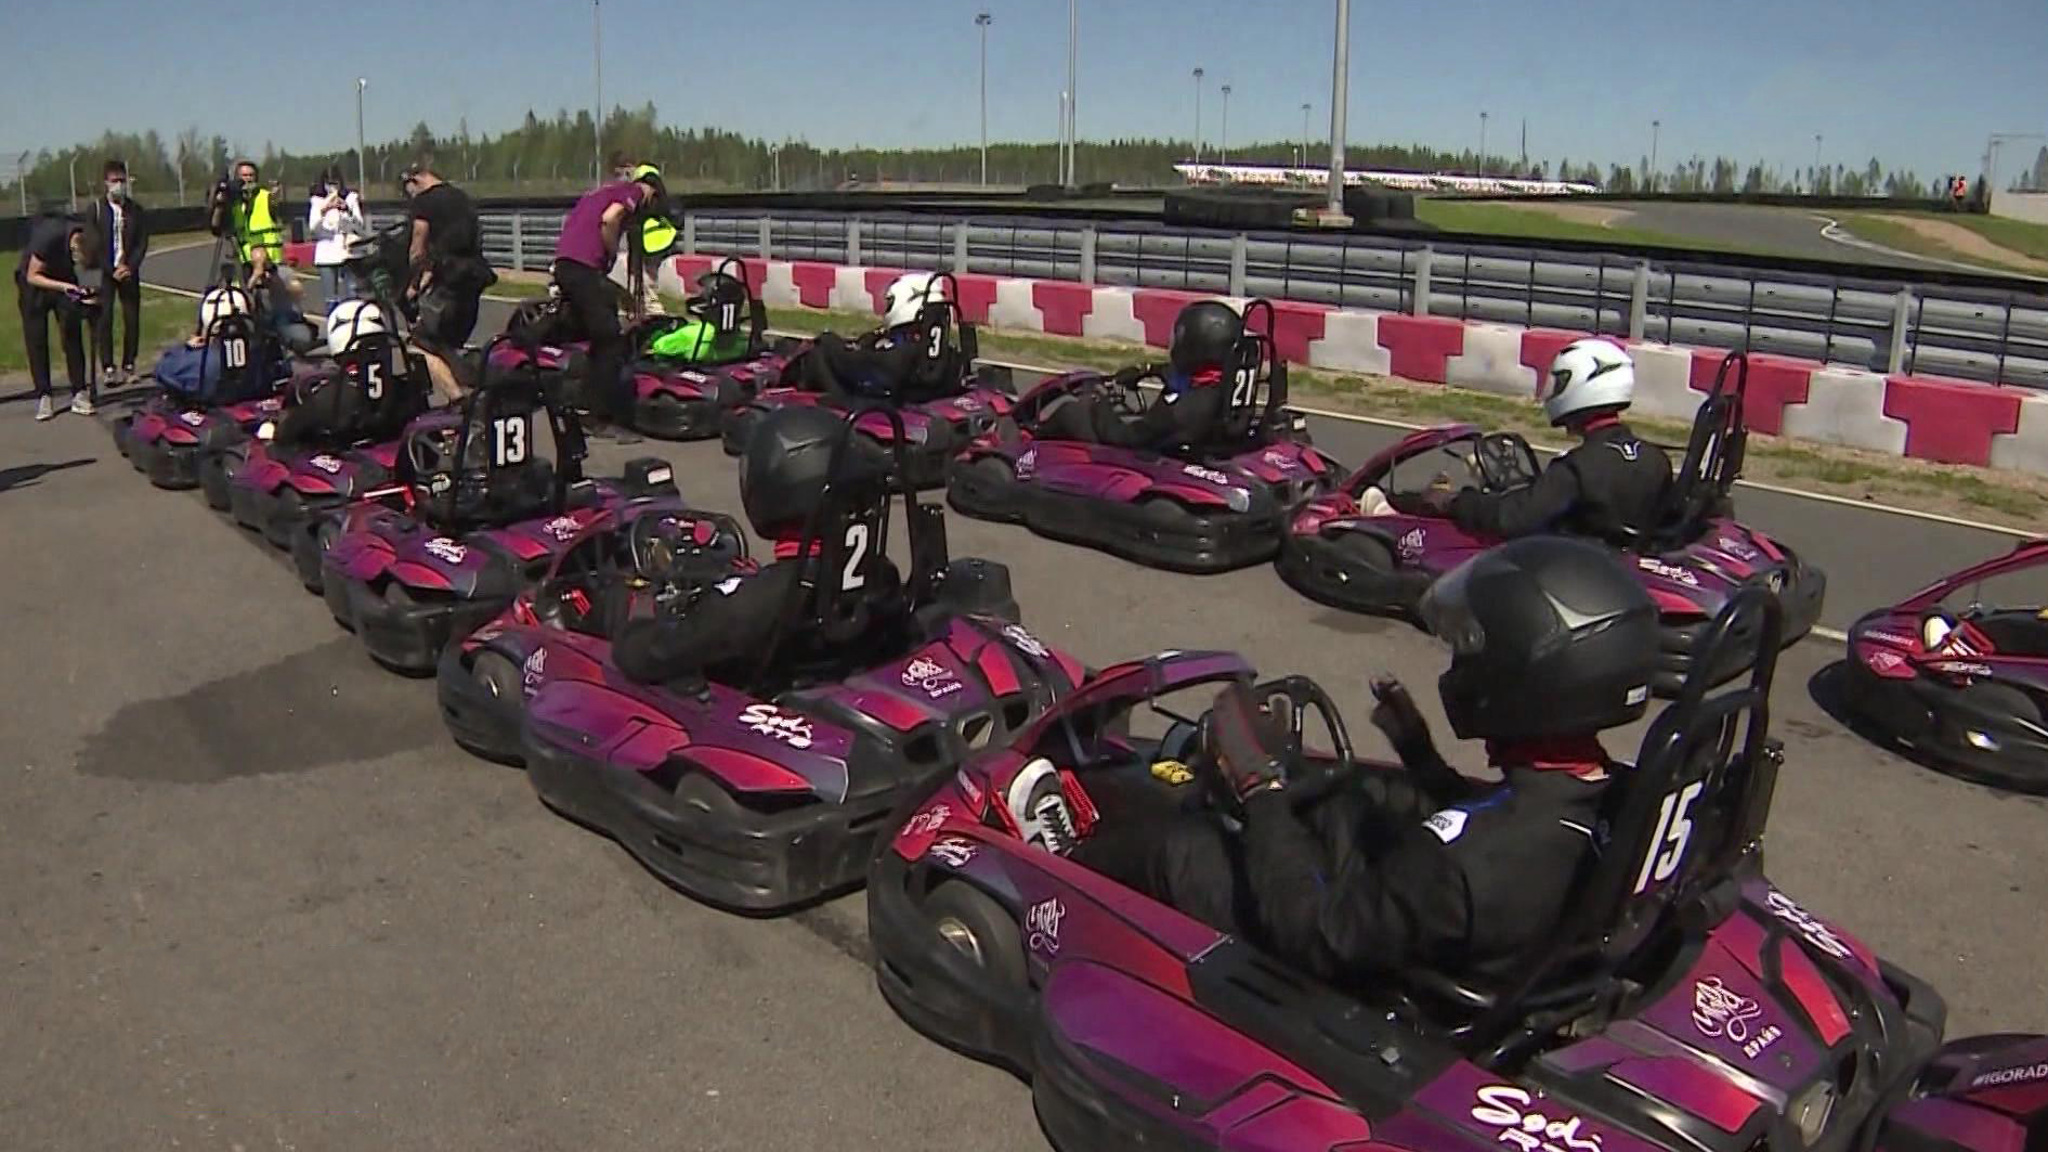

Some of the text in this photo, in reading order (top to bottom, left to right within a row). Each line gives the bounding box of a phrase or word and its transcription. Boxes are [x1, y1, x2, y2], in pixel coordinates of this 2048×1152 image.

[223, 338, 247, 369] 10
[928, 325, 942, 359] 3
[367, 362, 383, 400] 5
[1231, 367, 1255, 407] 21
[493, 416, 526, 467] 13
[841, 523, 869, 591] 2
[1633, 780, 1704, 895] 15
[1471, 1085, 1603, 1152] Sodi
